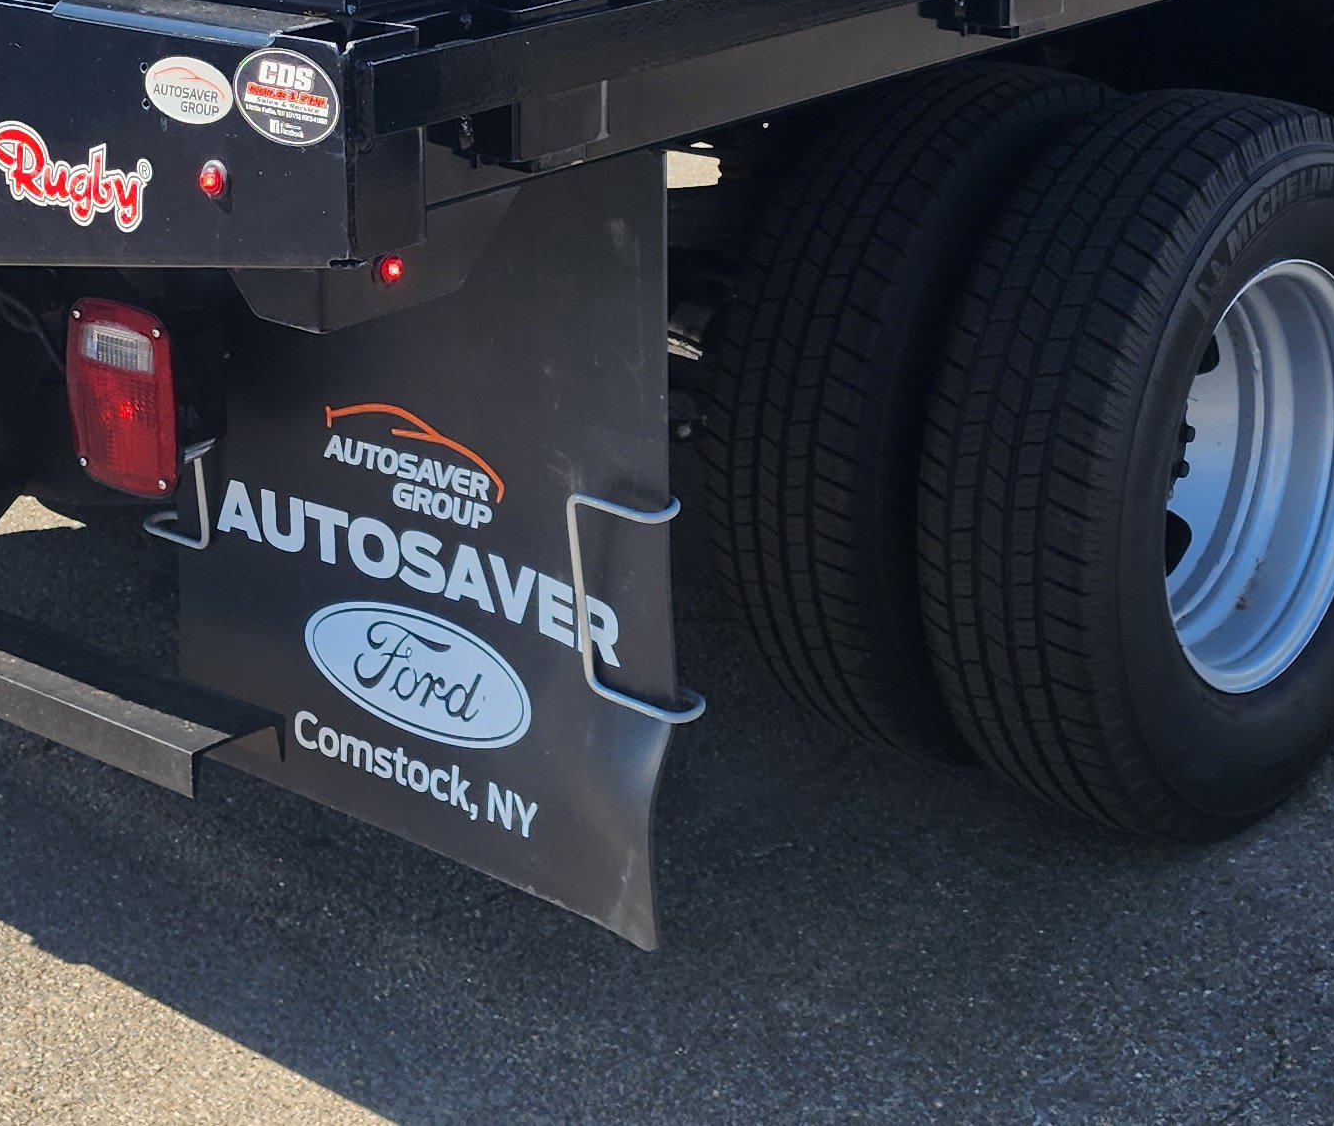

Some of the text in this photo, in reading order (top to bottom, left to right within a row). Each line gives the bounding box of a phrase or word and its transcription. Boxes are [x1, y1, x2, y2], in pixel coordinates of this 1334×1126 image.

[152, 83, 219, 103] AUTOSAVER
[180, 101, 220, 117] GROUP
[258, 60, 314, 93] CDS
[1226, 165, 1334, 266] MICHELIN
[323, 434, 490, 502] AUTOSAVER
[392, 482, 493, 530] GROUP
[216, 478, 621, 669] AUTOSAVER
[353, 619, 483, 724] Ford
[293, 710, 539, 840] Comstock, NY
